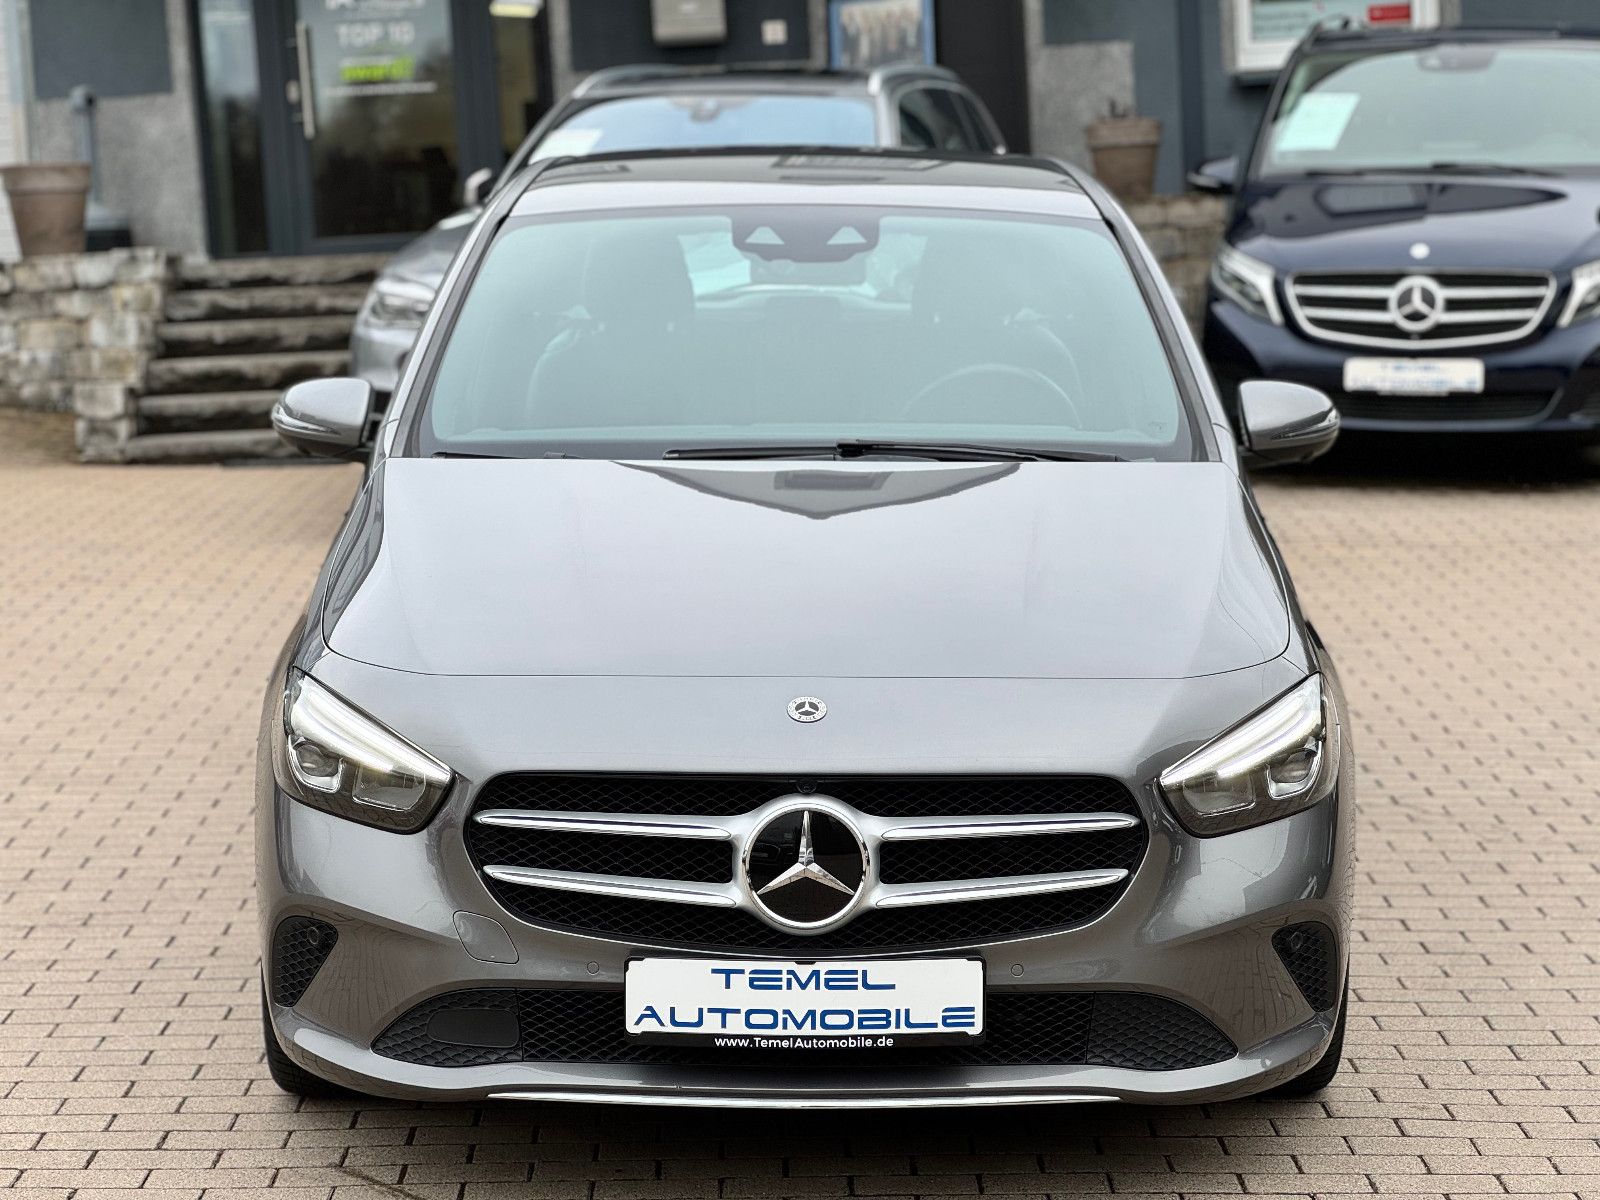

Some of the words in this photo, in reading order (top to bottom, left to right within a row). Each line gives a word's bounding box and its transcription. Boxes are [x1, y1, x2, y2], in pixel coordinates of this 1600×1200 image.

[337, 22, 383, 47] TOP
[711, 968, 896, 990] TEMEL
[633, 1005, 976, 1031] AUTOMOBILE
[714, 1036, 894, 1048] www.TemelAutomobile.de
